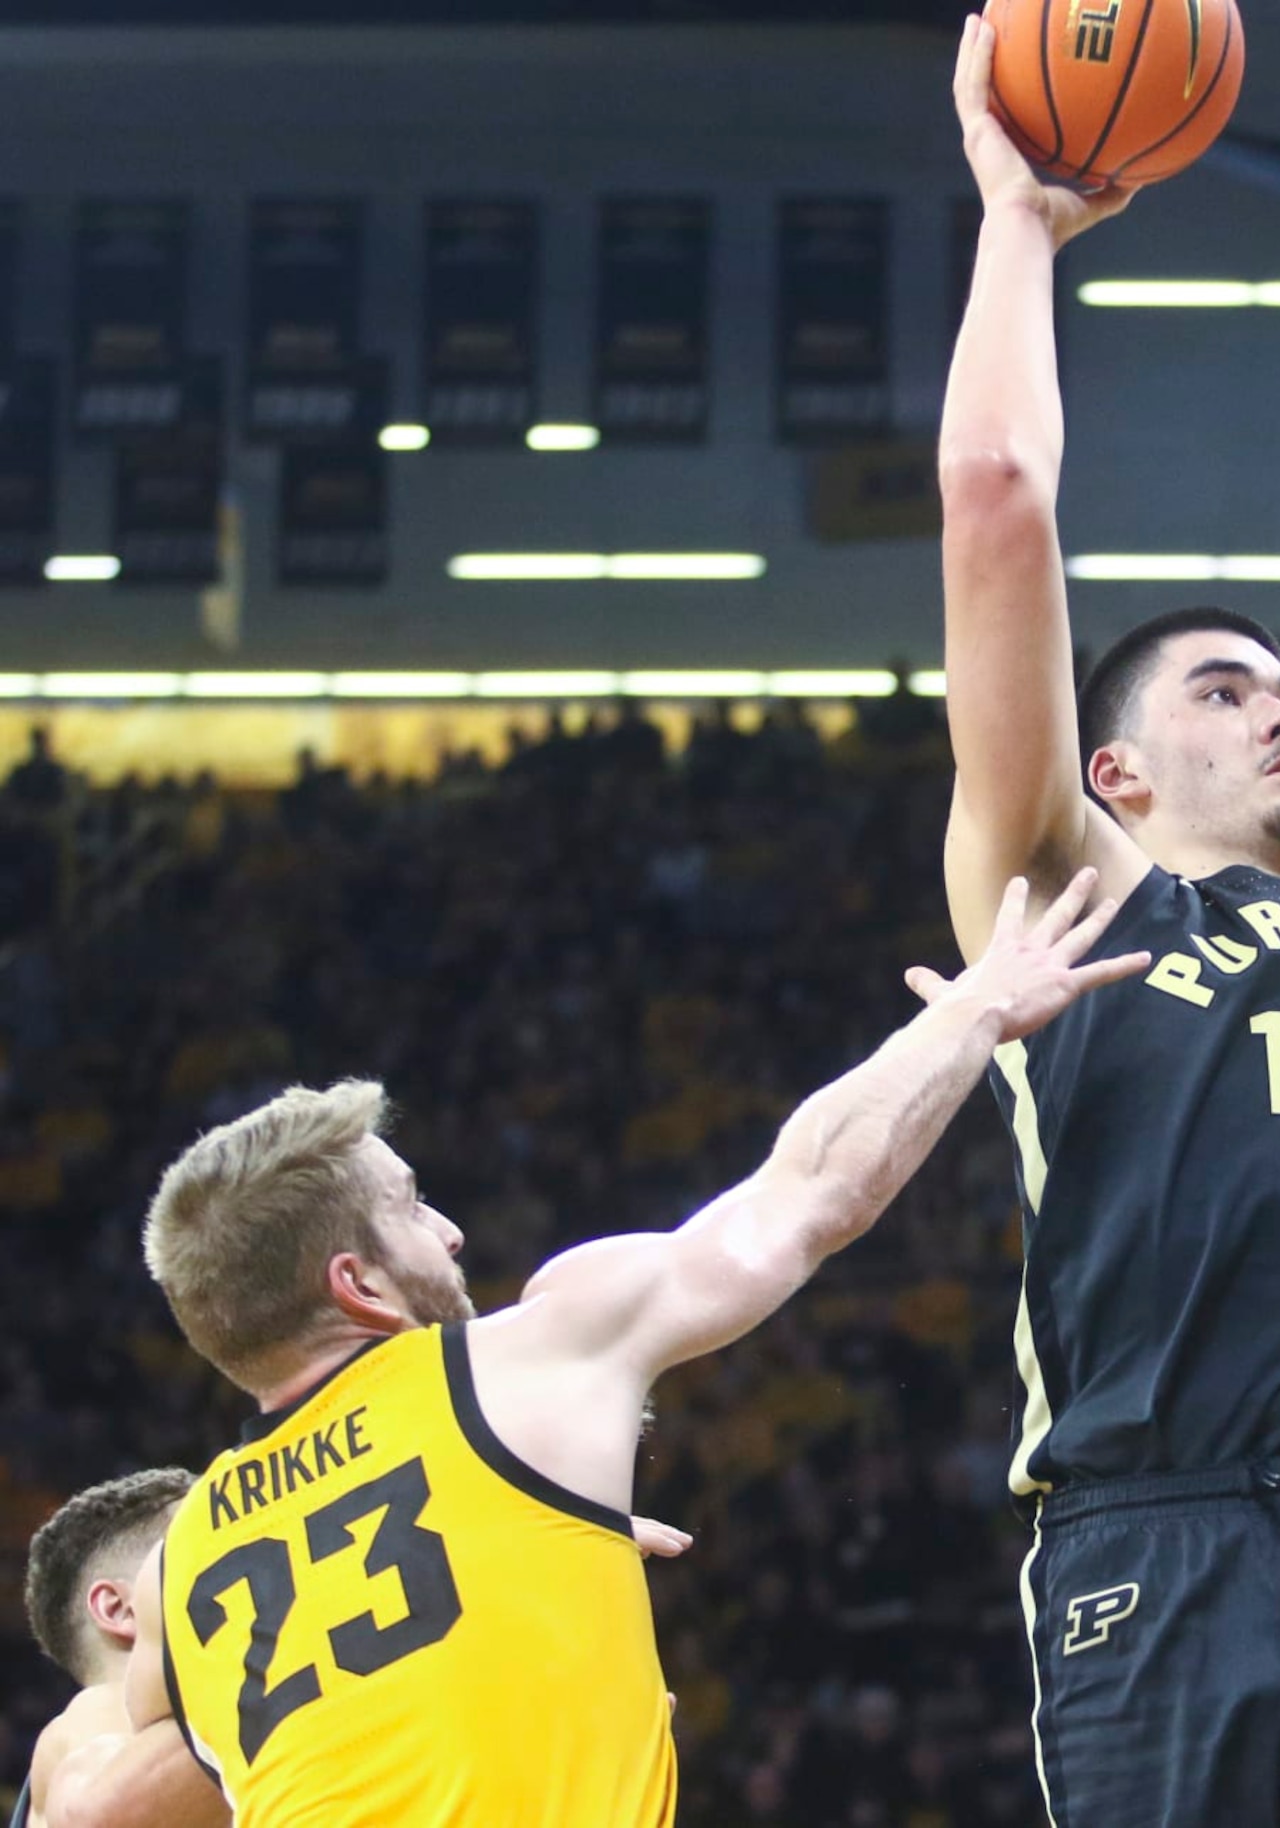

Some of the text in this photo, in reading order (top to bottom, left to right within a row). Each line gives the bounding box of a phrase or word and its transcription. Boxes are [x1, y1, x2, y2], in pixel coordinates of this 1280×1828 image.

[209, 1405, 373, 1531] KRIKKE
[186, 1455, 463, 1768] 23
[1063, 1582, 1140, 1656] P
